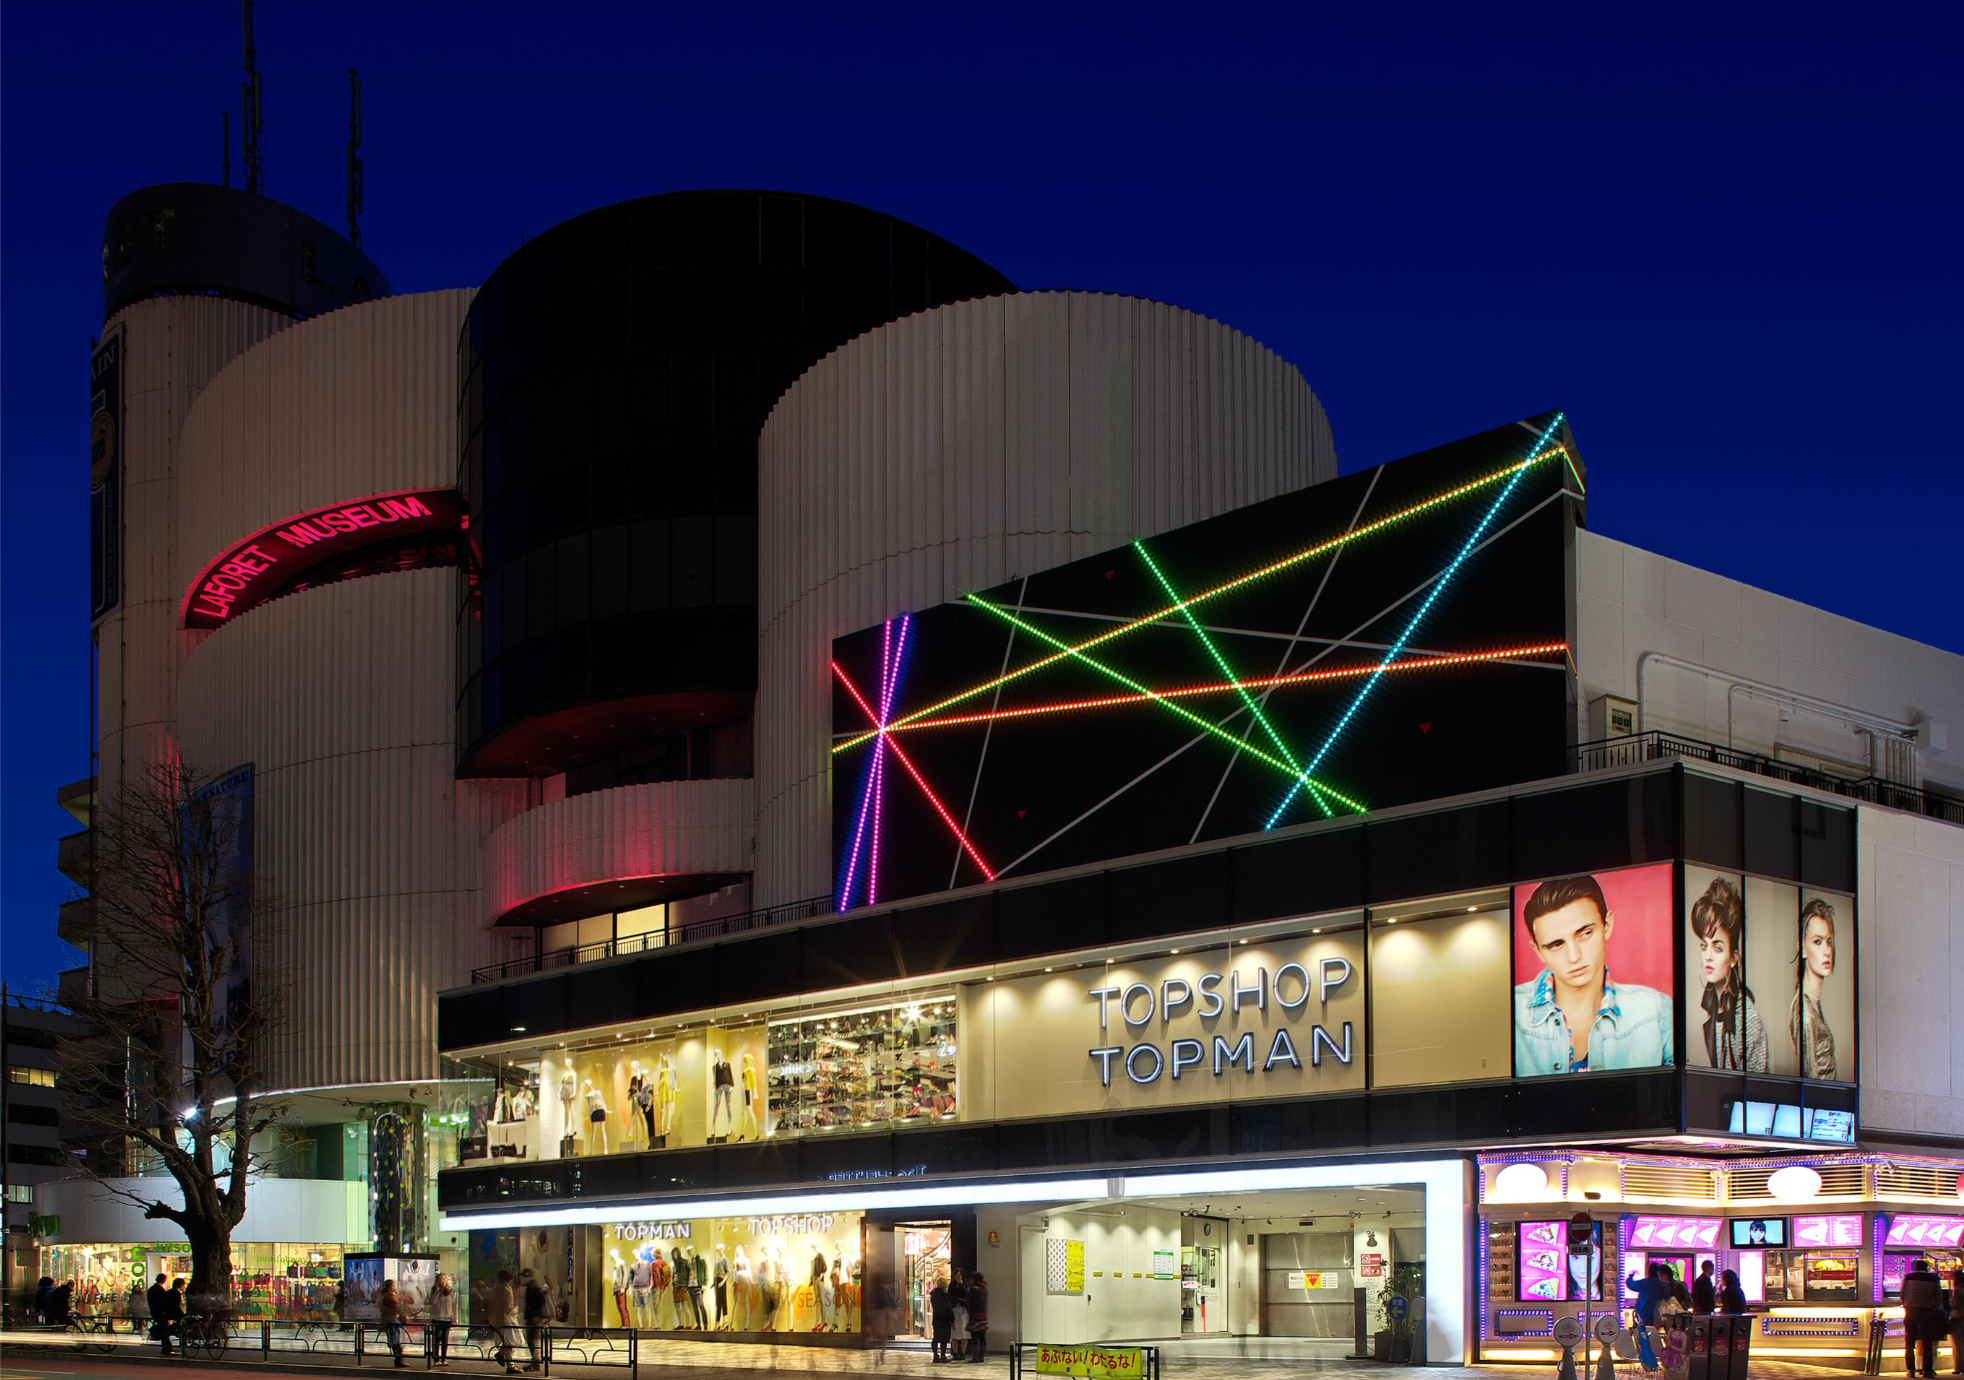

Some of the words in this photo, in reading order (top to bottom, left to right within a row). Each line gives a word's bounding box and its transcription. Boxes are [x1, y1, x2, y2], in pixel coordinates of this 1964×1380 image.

[193, 543, 279, 619] LAFORET
[281, 496, 434, 549] MUSEUM
[209, 770, 249, 799] NATURE
[1088, 957, 1353, 1030] TOPSHOP
[1088, 1021, 1353, 1087] TOPMAN
[615, 1222, 691, 1241] TOPMAN
[749, 1214, 834, 1237] TOPSHOP
[155, 1240, 191, 1253] kitso
[797, 1291, 856, 1308] SEASON
